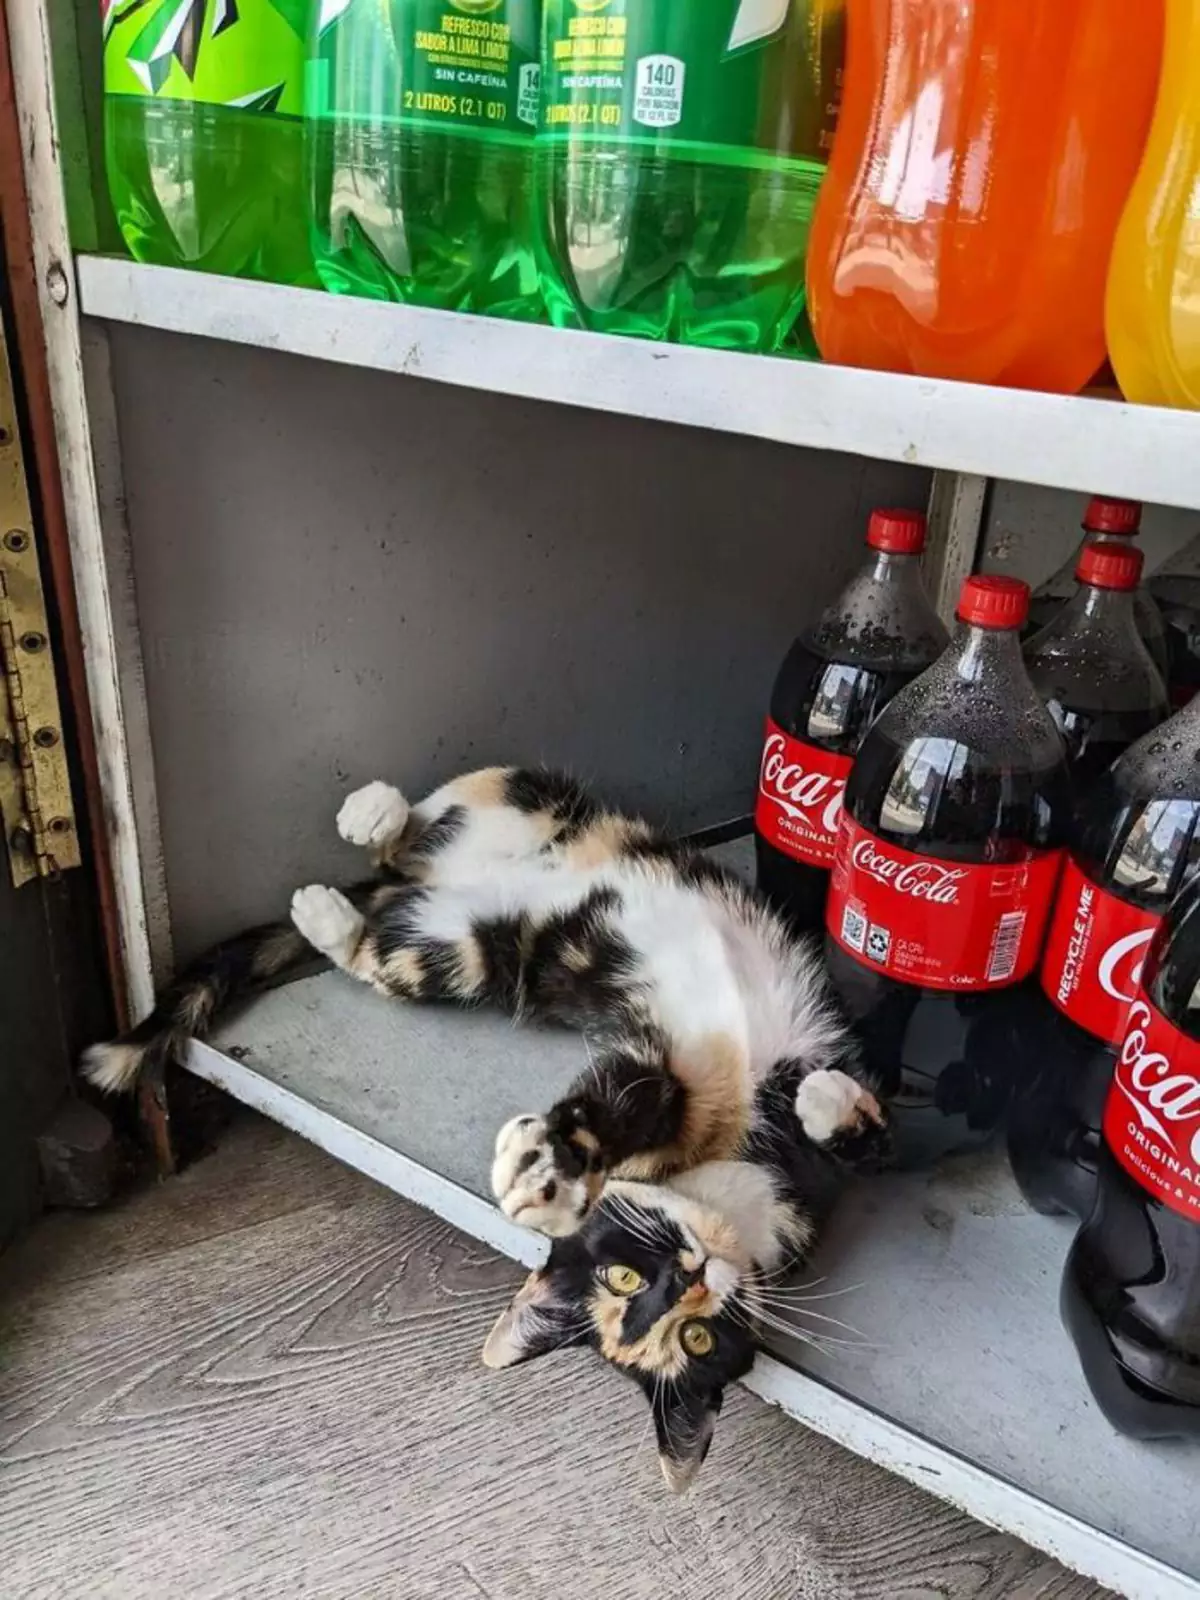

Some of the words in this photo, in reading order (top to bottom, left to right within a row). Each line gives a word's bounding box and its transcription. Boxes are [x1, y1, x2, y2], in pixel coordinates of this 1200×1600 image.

[435, 68, 455, 81] SIN
[526, 69, 540, 88] 14
[646, 63, 675, 86] 140
[404, 90, 413, 109] 2
[416, 92, 456, 113] LITROS
[460, 97, 482, 117] (2.1
[853, 840, 971, 903] Coca-Cola
[1057, 918, 1086, 1006] RECYCLE
[1077, 883, 1095, 919] ME
[1114, 1000, 1200, 1156] Coca
